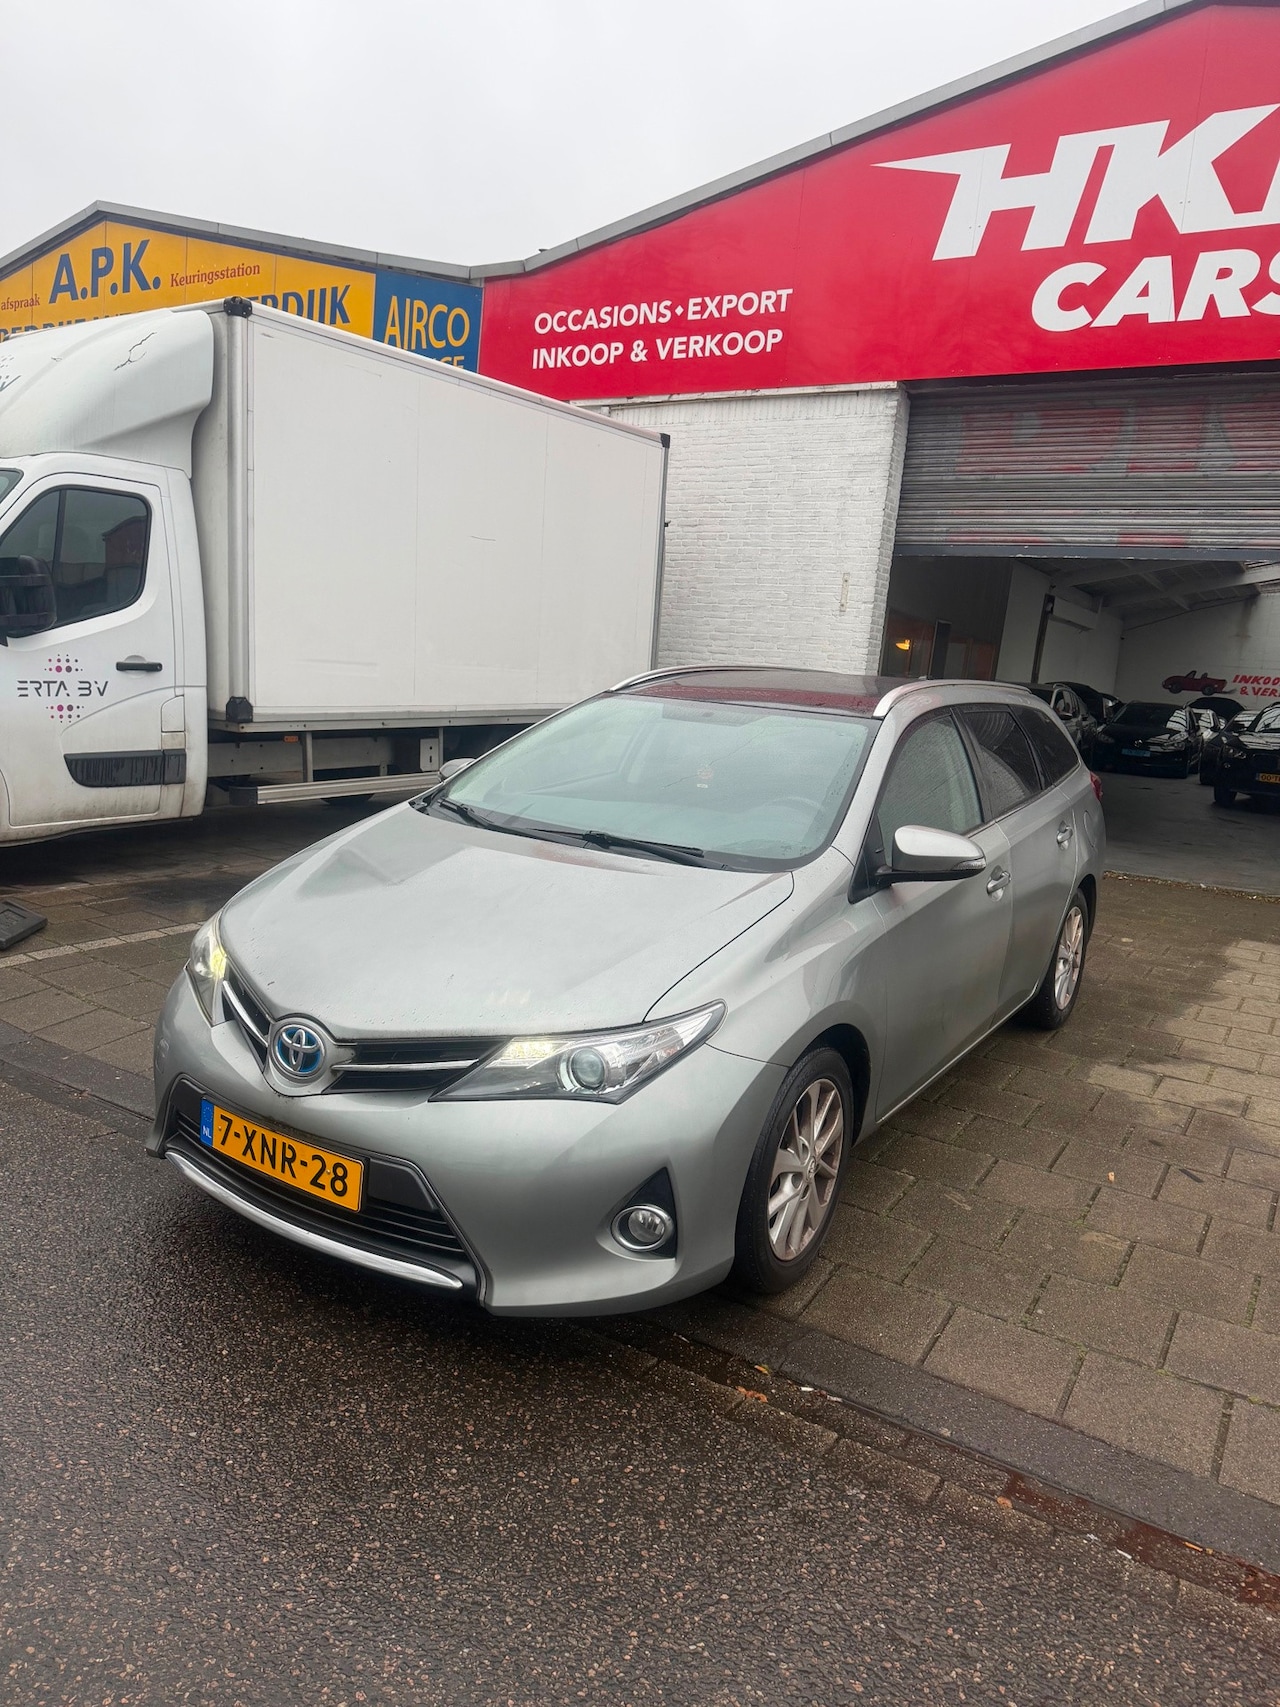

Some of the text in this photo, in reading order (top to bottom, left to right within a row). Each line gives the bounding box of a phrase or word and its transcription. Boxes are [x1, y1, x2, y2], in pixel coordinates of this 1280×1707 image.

[869, 103, 1280, 261] HK
[48, 238, 162, 304] A.P.K.
[169, 262, 261, 288] Keuringsstation
[0, 293, 41, 312] afspraak
[383, 295, 470, 351] AIRCO
[533, 288, 794, 335] OCCASIONS EXPORT
[532, 328, 784, 370] INKOOP & VERKOOP
[17, 680, 109, 698] ERTA BV
[1251, 686, 1280, 698] VER
[202, 1113, 348, 1197] NL 7-XNR-28
